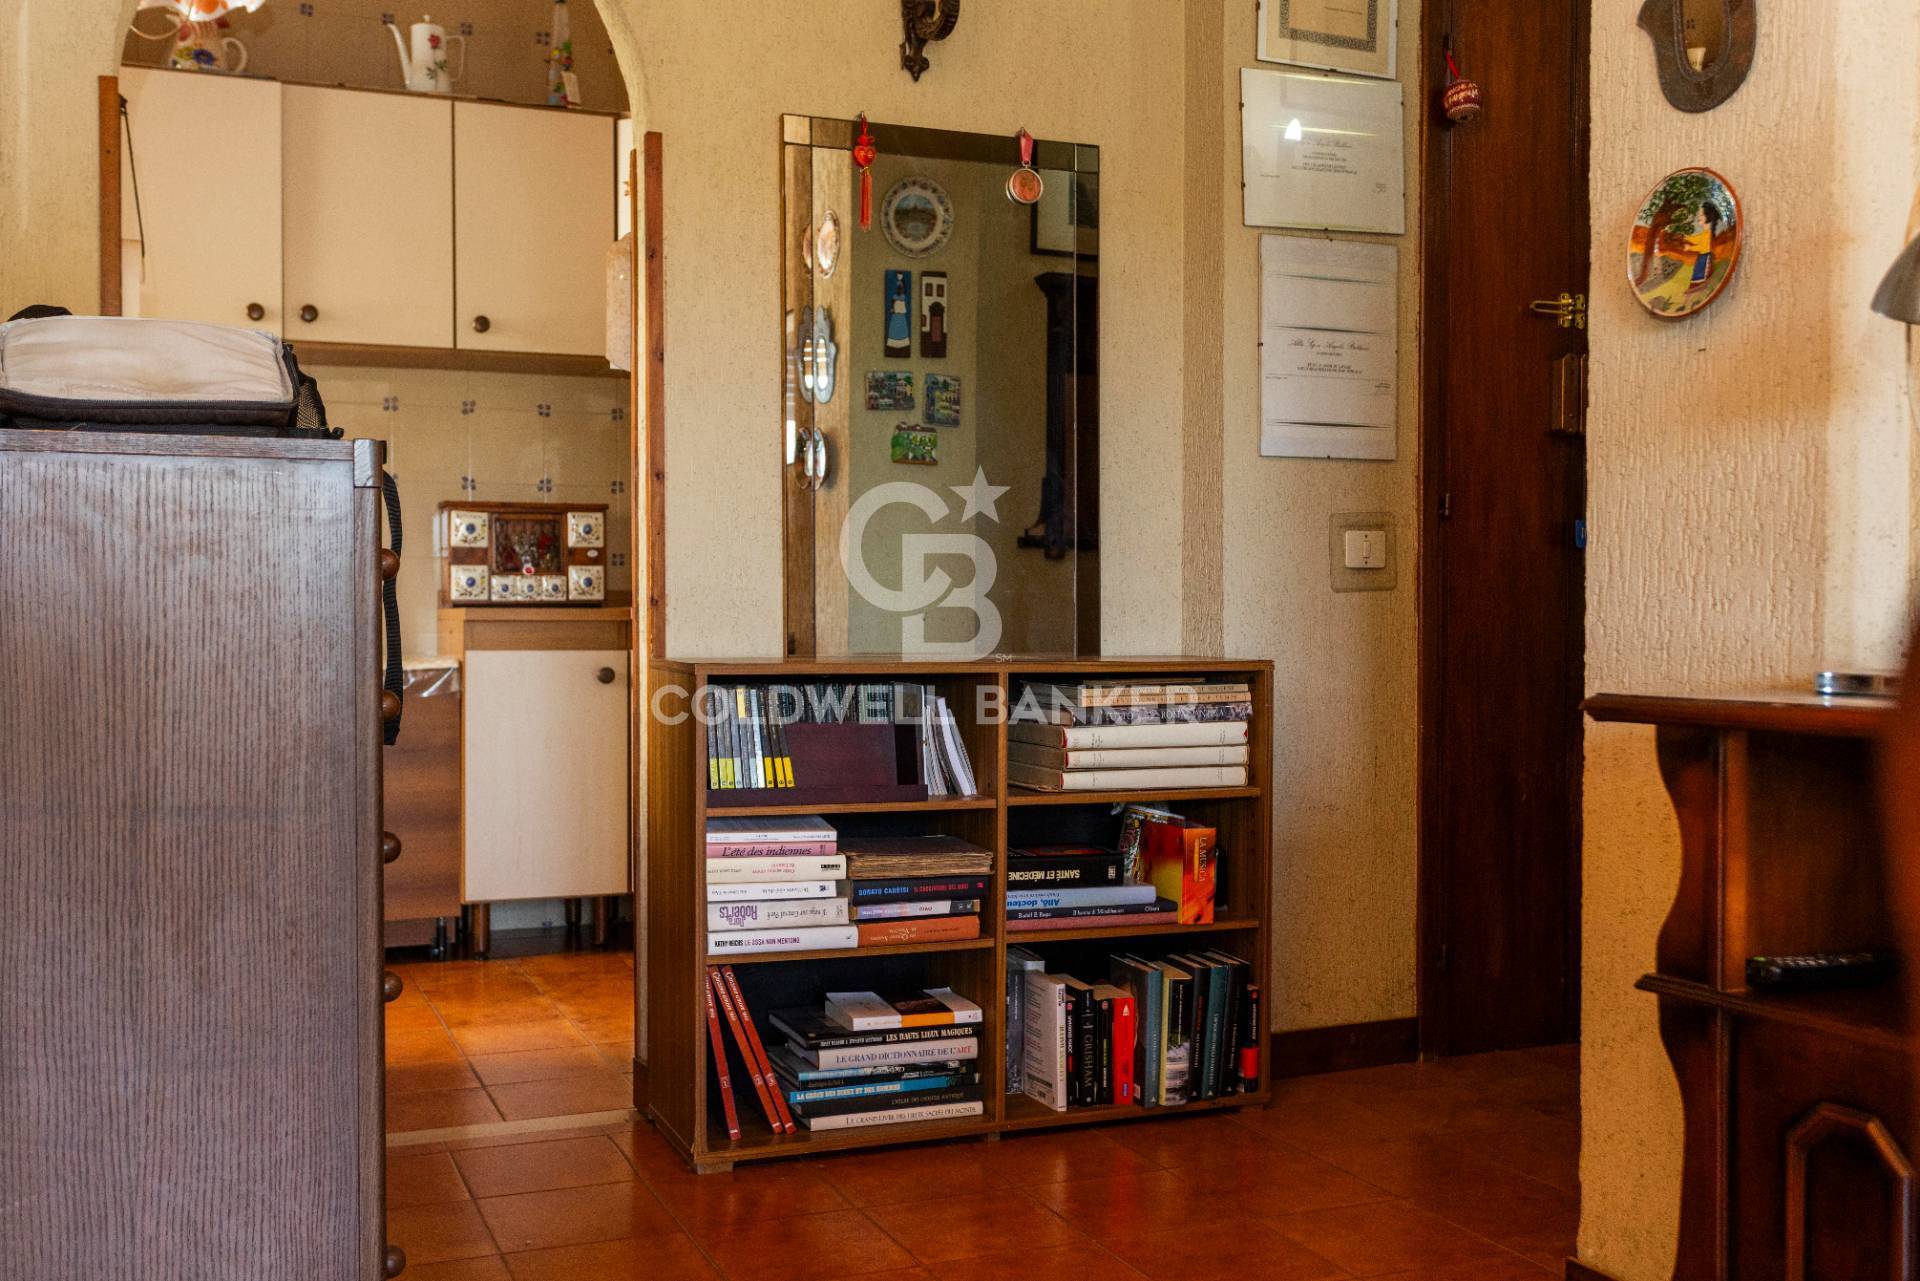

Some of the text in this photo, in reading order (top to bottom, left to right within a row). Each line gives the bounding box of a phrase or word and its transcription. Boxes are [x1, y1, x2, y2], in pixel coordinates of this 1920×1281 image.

[747, 846, 764, 857] des
[765, 845, 812, 856] indiennes
[1008, 869, 1081, 883] SANTÉ ET MÉDECINE
[1007, 899, 1038, 907] docteu
[719, 905, 758, 920] Roberts
[777, 936, 800, 945] MENTONO
[885, 1027, 973, 1042] LES HAUTS LIEUX MAGIQUES
[836, 1046, 972, 1064] LE GRAND DICTIONNAIRE DE L'ART
[1083, 1034, 1094, 1087] GRISHAM
[796, 1092, 805, 1100] LA
[855, 1115, 877, 1124] GRAND
[877, 1114, 895, 1123] LIVRE
[954, 1106, 977, 1115] MONDE
